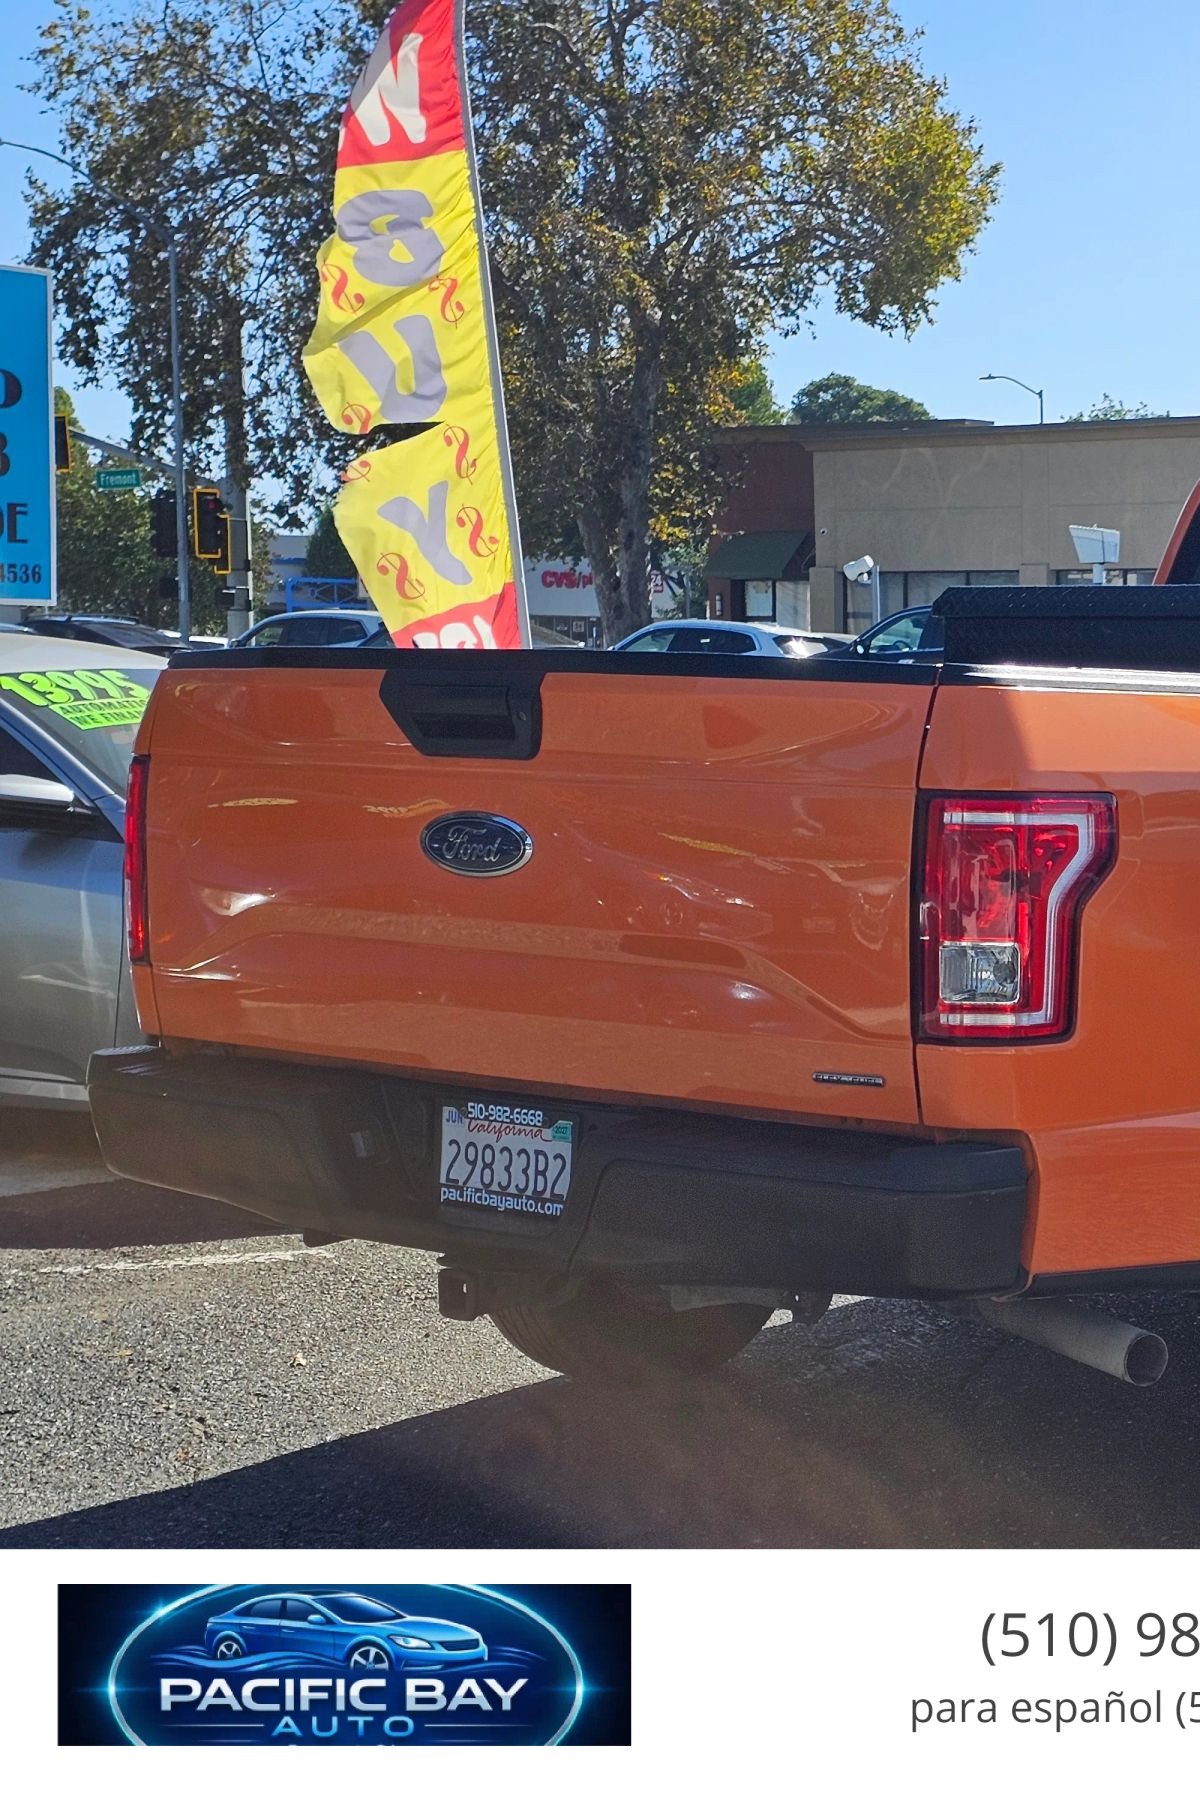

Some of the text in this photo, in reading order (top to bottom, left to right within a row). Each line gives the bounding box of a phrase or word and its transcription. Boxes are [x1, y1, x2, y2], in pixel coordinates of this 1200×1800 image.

[100, 472, 137, 486] Fremont
[0, 670, 149, 706] 13995
[442, 825, 502, 862] Ford
[467, 1102, 543, 1127] 510-982-6668
[467, 1119, 553, 1144] California
[445, 1138, 567, 1201] 29833B2
